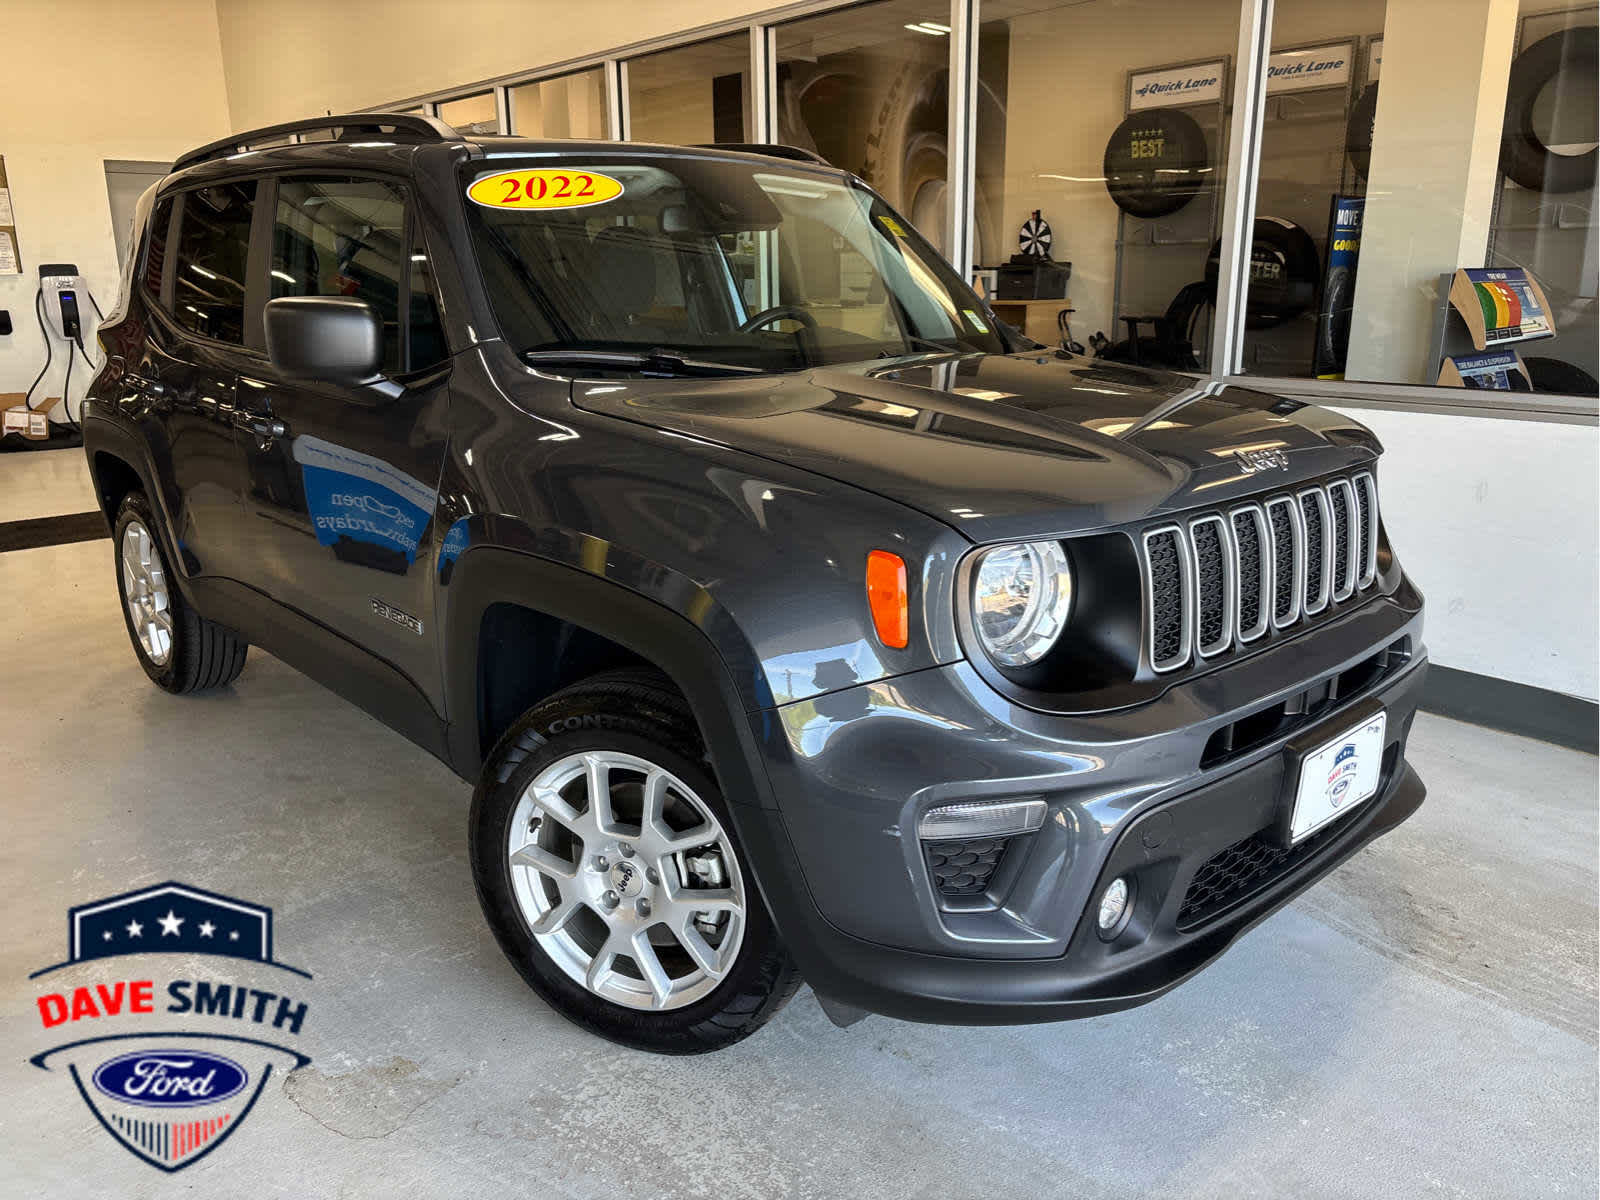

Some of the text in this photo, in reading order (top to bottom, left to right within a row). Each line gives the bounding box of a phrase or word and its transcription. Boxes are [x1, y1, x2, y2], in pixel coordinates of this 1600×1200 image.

[1267, 63, 1304, 78] Quick
[1305, 60, 1344, 73] Lane
[1149, 80, 1184, 94] Quick
[1184, 77, 1217, 89] Lane
[1130, 139, 1164, 158] BEST
[1336, 209, 1359, 226] MOVE
[1249, 261, 1281, 279] TTER
[1233, 448, 1289, 474] Jeep
[368, 598, 424, 635] RENEGADE
[617, 868, 633, 892] Jeep
